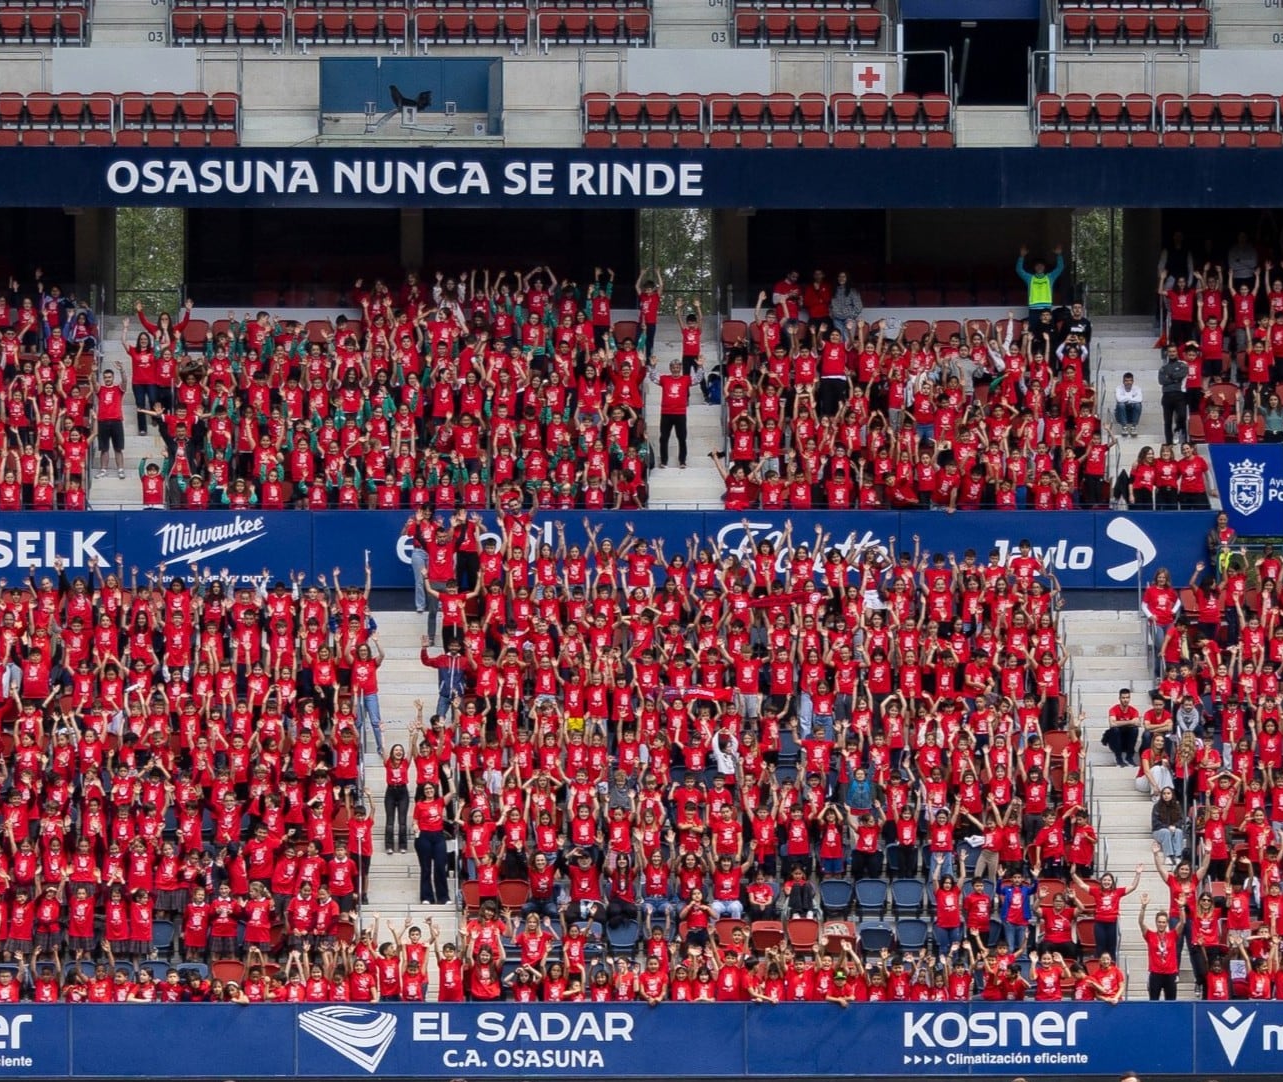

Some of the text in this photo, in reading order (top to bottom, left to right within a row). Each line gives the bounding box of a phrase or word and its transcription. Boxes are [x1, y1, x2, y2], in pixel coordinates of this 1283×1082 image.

[148, 31, 163, 42] 03
[711, 32, 726, 43] 03
[106, 160, 704, 197] OSASUNA NUNCA SE RINDE
[154, 515, 265, 556] Milwaukee
[988, 539, 1093, 576] Jylo
[412, 1011, 634, 1042] EL SADAR
[443, 1050, 605, 1068] C.A. OSASUNA
[946, 1052, 1089, 1065] Climatización eficiente
